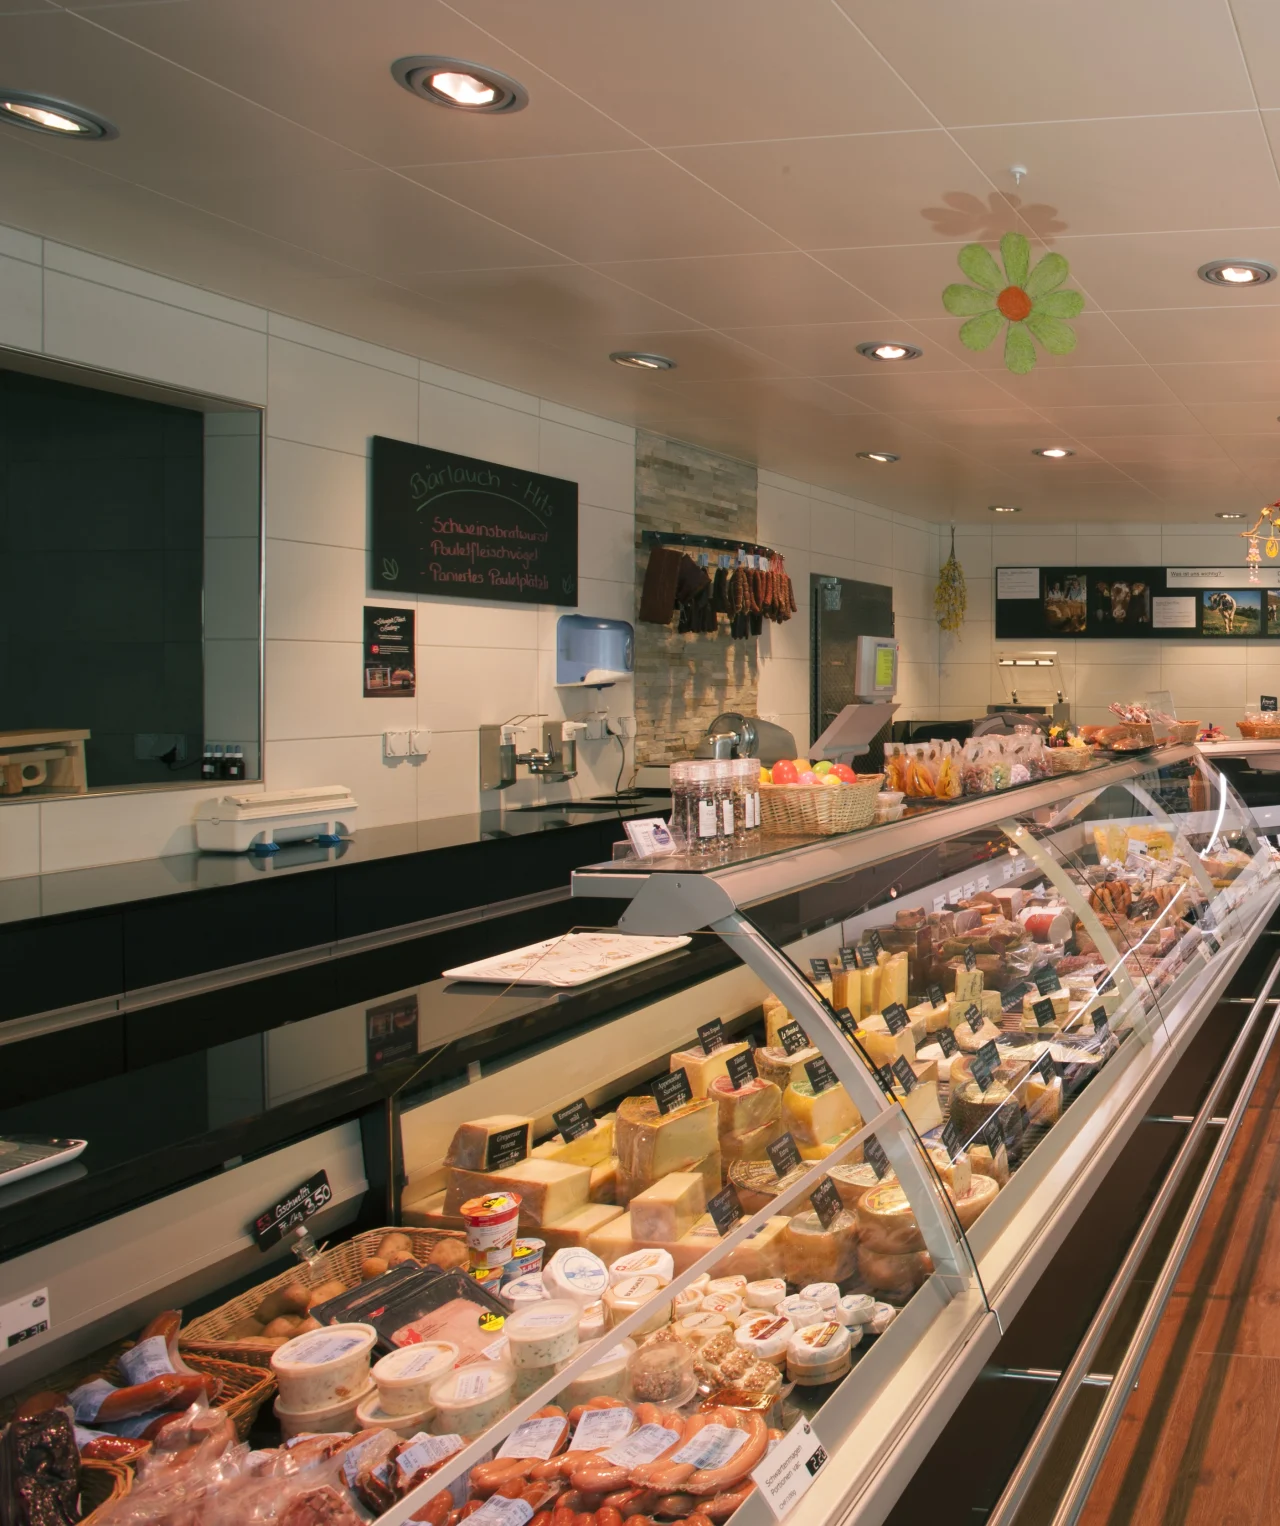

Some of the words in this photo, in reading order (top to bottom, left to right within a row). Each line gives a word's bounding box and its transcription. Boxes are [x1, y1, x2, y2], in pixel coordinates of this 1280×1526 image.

[410, 464, 500, 499] Bärlauch
[523, 481, 553, 517] Hits
[432, 516, 548, 542] Schweinsbratwurst
[431, 539, 538, 570] Pouletfleischvögel
[429, 562, 484, 584] Paniertes
[488, 568, 549, 592] Pouletplätzli
[275, 1184, 310, 1218] Gschwellti
[304, 1184, 330, 1215] 3.50
[765, 1445, 803, 1487] Schwartenmagen
[770, 1470, 794, 1497] Portionen
[793, 1460, 802, 1473] vac
